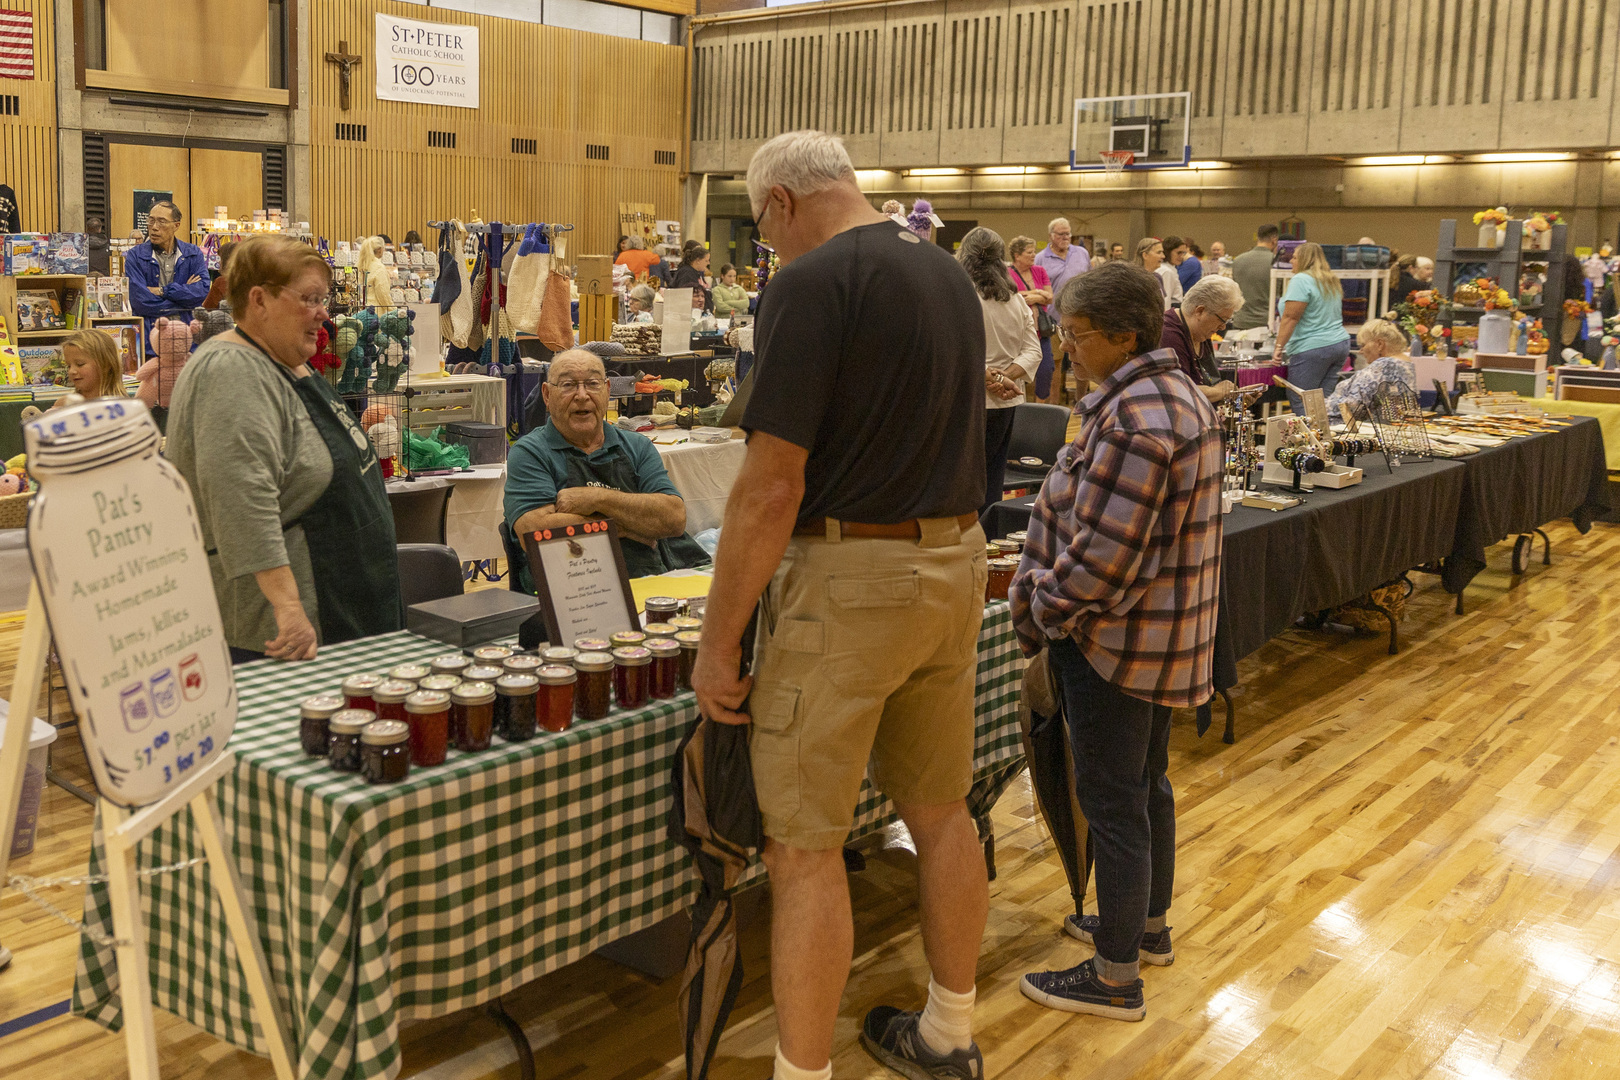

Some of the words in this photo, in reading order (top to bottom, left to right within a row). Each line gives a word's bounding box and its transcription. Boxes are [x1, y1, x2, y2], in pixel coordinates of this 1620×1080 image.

[391, 44, 432, 58] CATHOLIC
[433, 49, 465, 61] SCHOOL
[417, 28, 464, 50] PETER
[392, 64, 434, 86] 100
[436, 74, 466, 86] YEARS
[401, 87, 435, 96] UNLOCKING
[436, 90, 466, 98] POTENTIAL
[19, 348, 53, 358] Outdoor
[92, 484, 142, 525] Pat's
[87, 522, 152, 558] Pantry
[72, 564, 126, 602] Award
[126, 547, 189, 578] Winning
[95, 575, 178, 620] Homemade
[109, 629, 151, 656] Jams,
[151, 609, 189, 635] Jellies
[101, 659, 130, 689] and
[132, 625, 213, 674] Marmalades
[174, 724, 195, 751] per
[197, 711, 216, 735] jar
[163, 765, 172, 783] 3
[176, 751, 194, 774] for
[198, 736, 214, 758] 20
